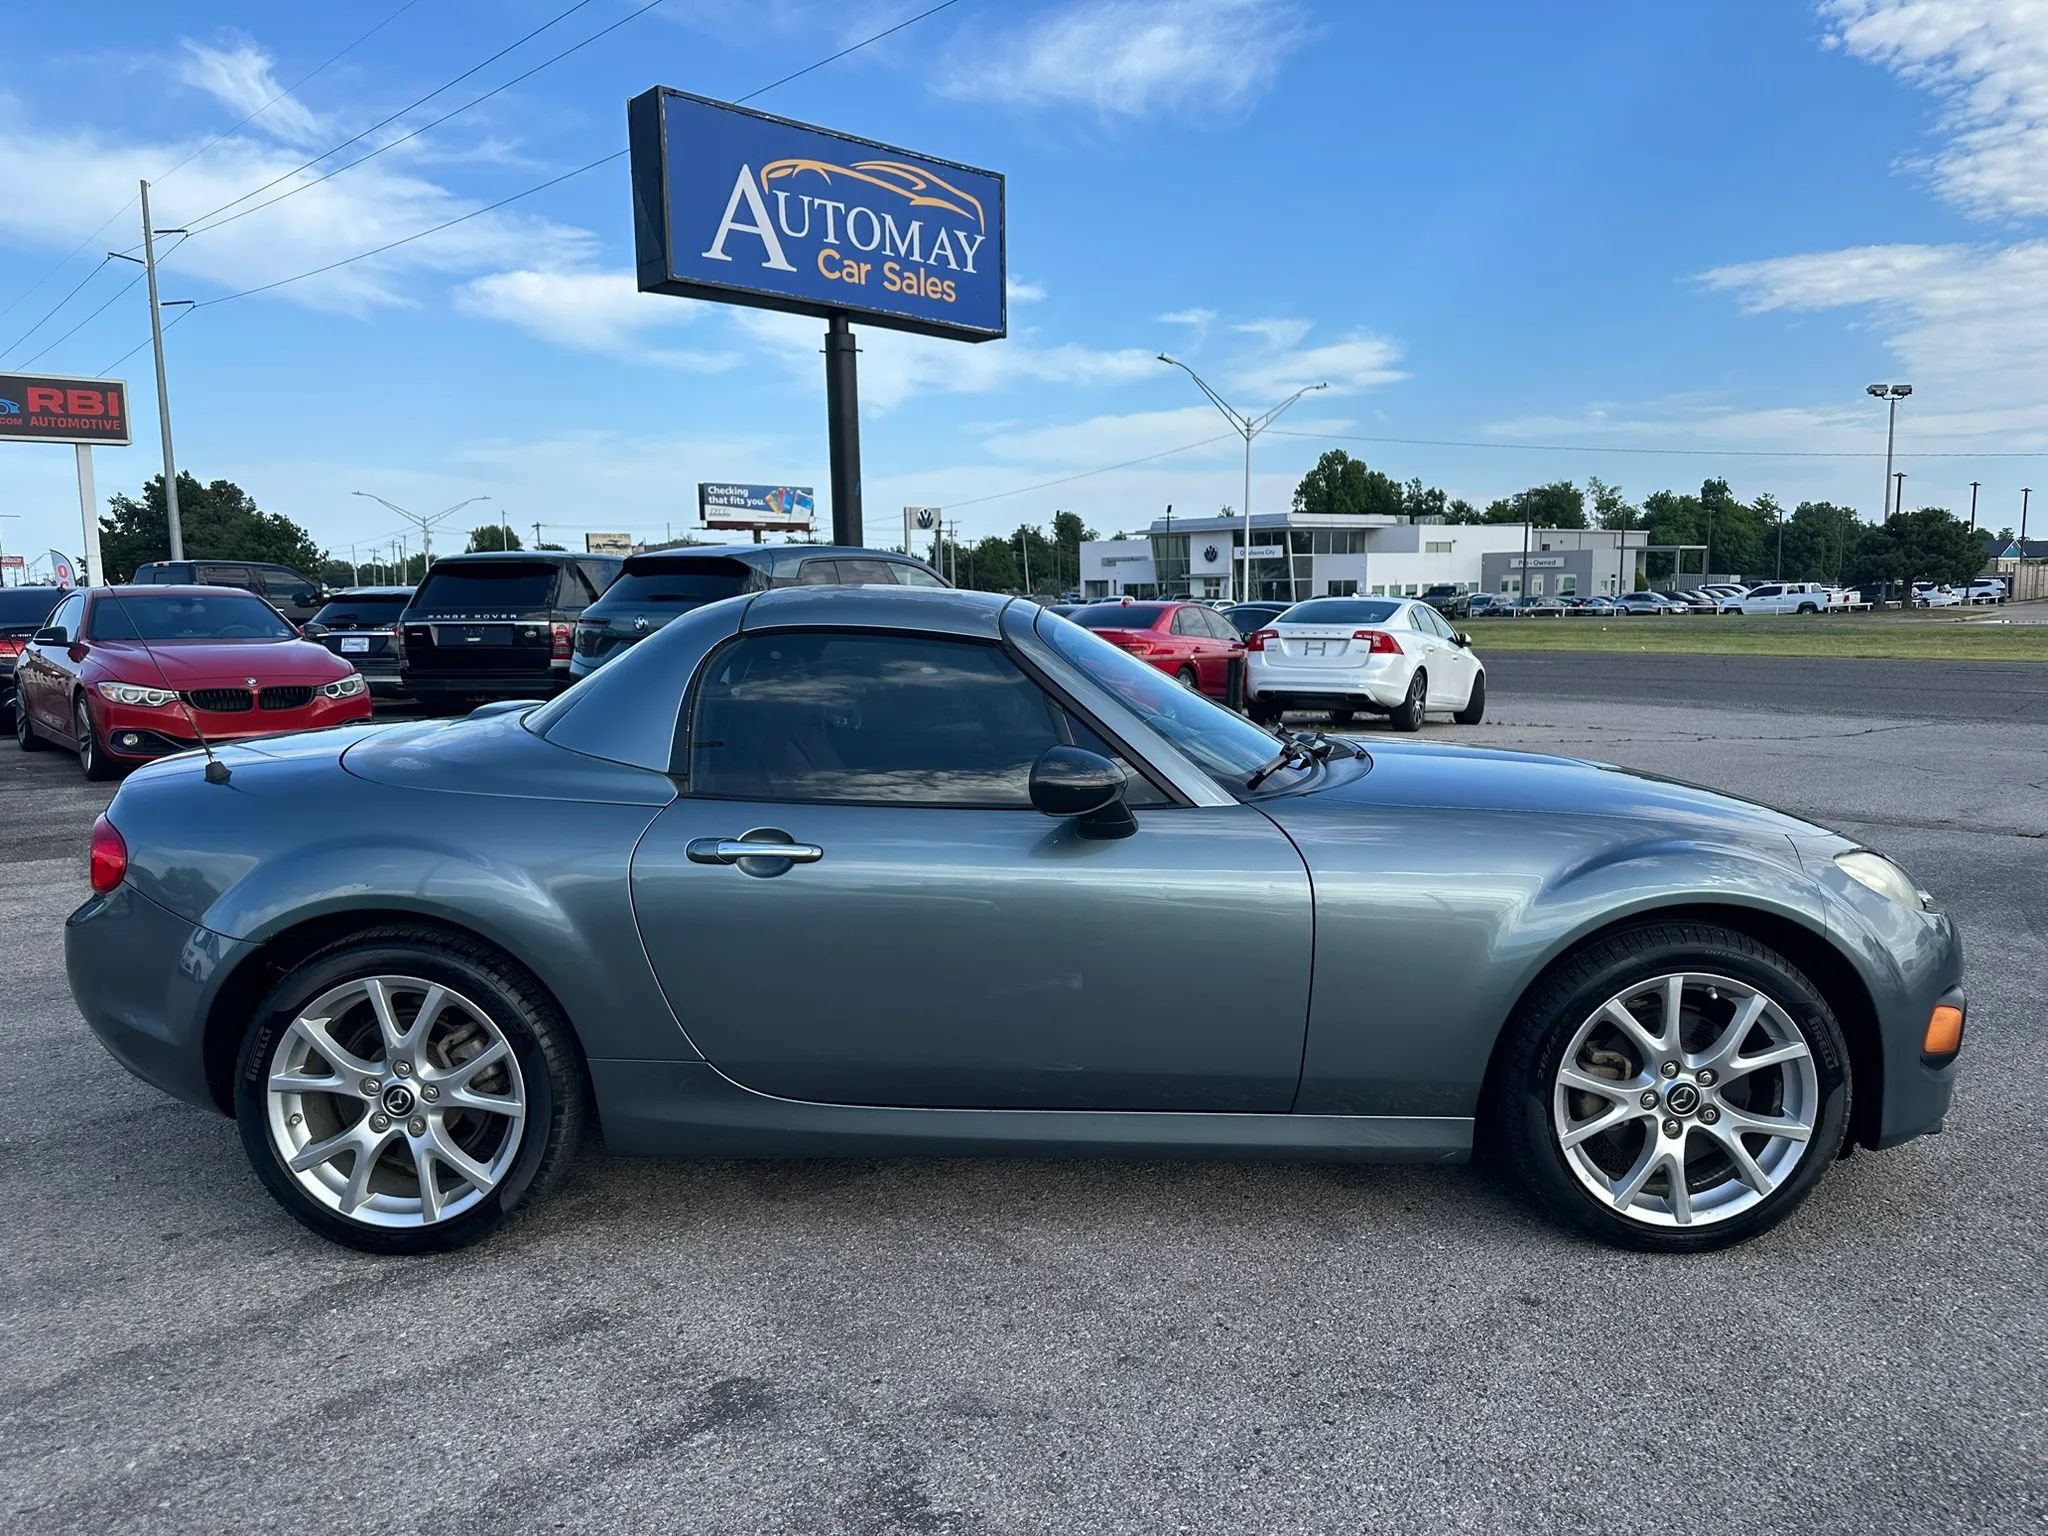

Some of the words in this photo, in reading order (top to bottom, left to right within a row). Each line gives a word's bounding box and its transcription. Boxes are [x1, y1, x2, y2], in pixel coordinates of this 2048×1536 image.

[701, 163, 987, 272] AUTOMAY
[817, 248, 872, 285] Car
[883, 261, 957, 302] Sales
[27, 386, 119, 417] RBI
[30, 416, 121, 430] AUTOMOTIVE
[708, 486, 749, 498] Checking
[708, 496, 727, 505] that
[729, 497, 746, 505] fits
[747, 499, 766, 507] you.
[245, 1025, 272, 1081] PIRELLI
[1807, 1015, 1840, 1071] PIRELLI
